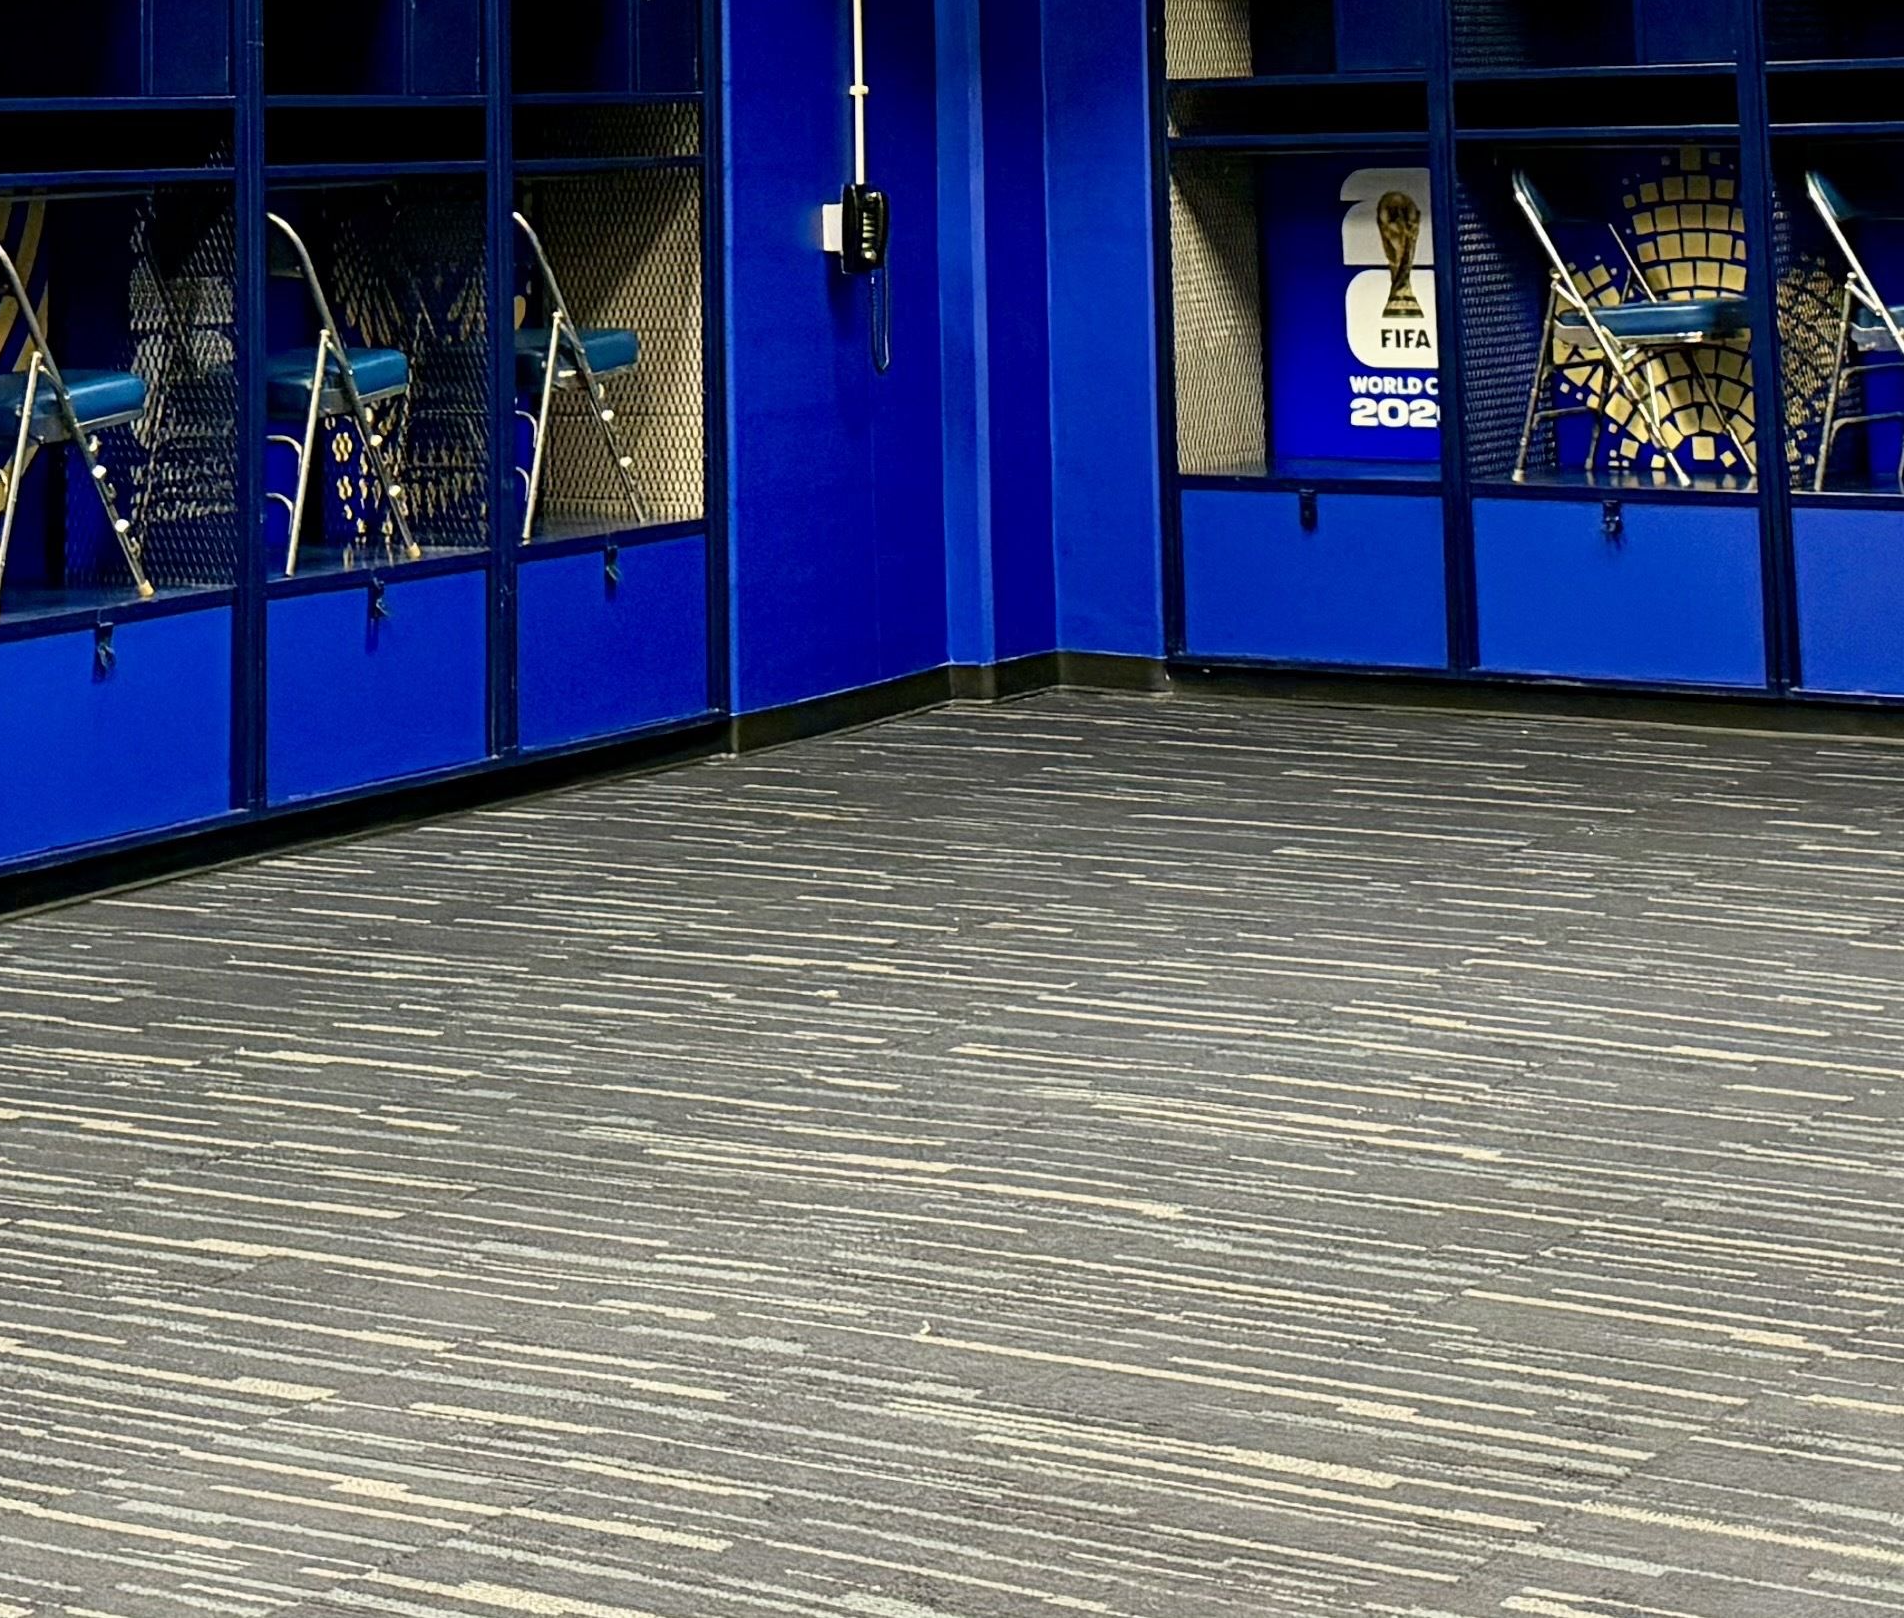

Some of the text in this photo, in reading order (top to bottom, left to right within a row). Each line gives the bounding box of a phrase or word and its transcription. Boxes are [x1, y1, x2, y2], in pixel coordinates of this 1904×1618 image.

[1380, 328, 1432, 349] FIFA
[1349, 375, 1423, 395] WORLD
[1349, 397, 1441, 428] 202
